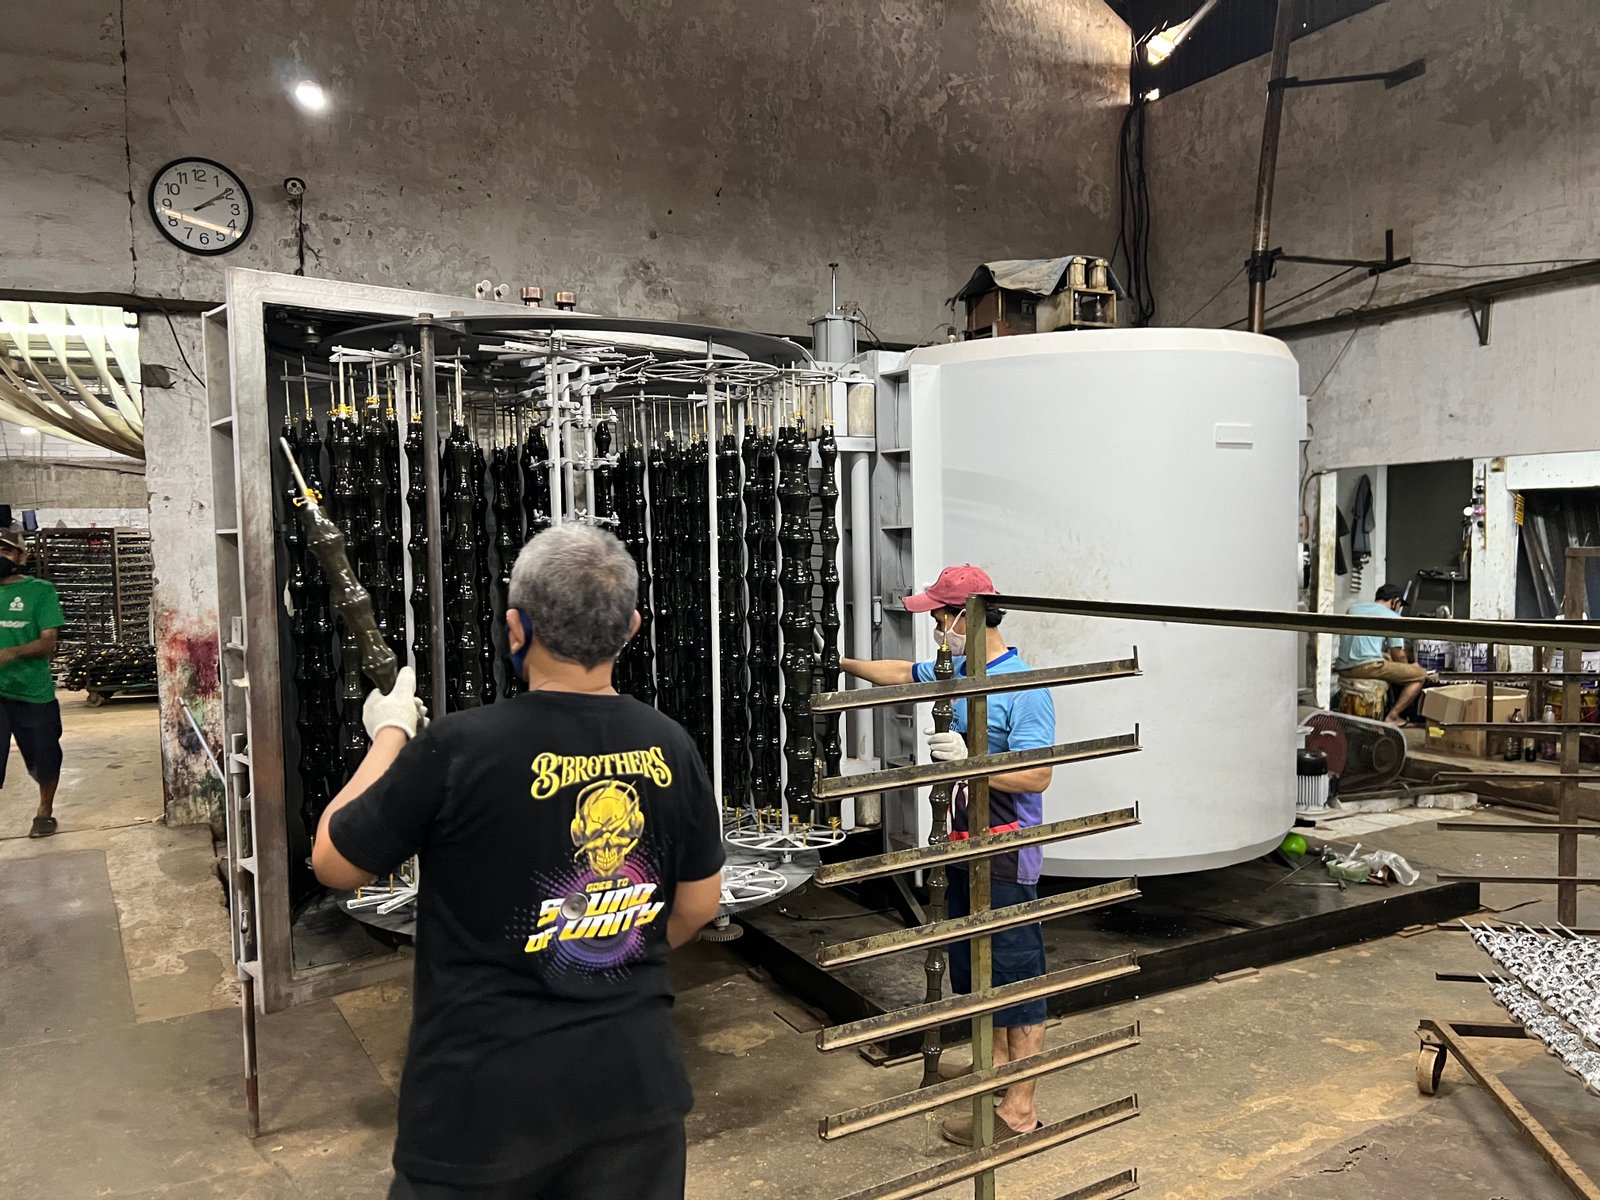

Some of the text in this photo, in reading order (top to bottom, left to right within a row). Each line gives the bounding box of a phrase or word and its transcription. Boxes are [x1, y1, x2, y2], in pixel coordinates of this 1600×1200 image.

[177, 172, 188, 185] 11
[191, 169, 207, 182] 12
[213, 175, 219, 188] 1
[164, 183, 180, 196] 10
[224, 187, 235, 200] 2
[162, 198, 172, 210] 9
[231, 203, 240, 216] 3
[168, 215, 179, 227] 8
[227, 219, 237, 231] 4
[184, 226, 193, 240] 7
[199, 232, 210, 245] 6
[216, 230, 226, 242] 5
[585, 877, 629, 893] GOES TO
[536, 882, 658, 928] SOUND
[524, 901, 666, 953] OF UNITY
